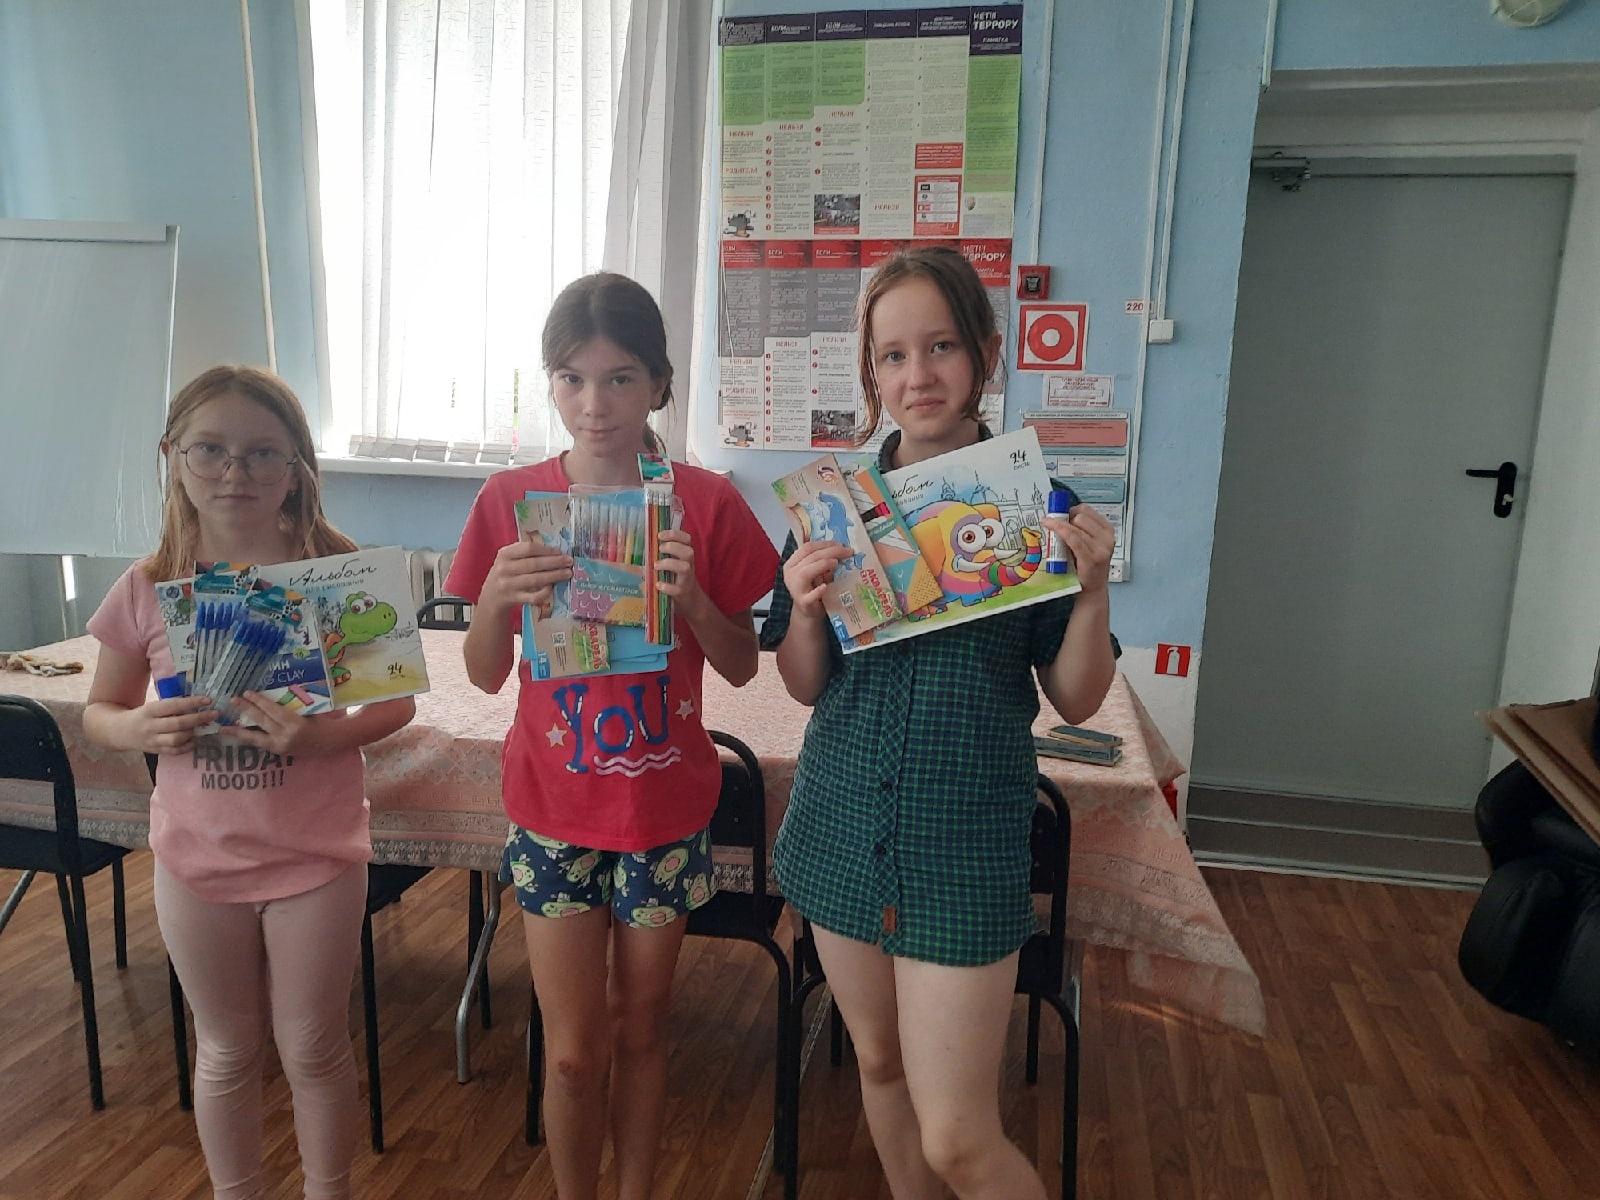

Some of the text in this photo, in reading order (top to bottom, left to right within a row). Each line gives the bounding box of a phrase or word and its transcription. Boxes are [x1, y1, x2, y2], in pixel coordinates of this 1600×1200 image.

[973, 19, 1019, 31] ТЕРРОРУ
[963, 252, 1006, 262] ТЕРРОРУ
[277, 669, 305, 683] CLAY
[201, 769, 285, 790] MOOD!!!
